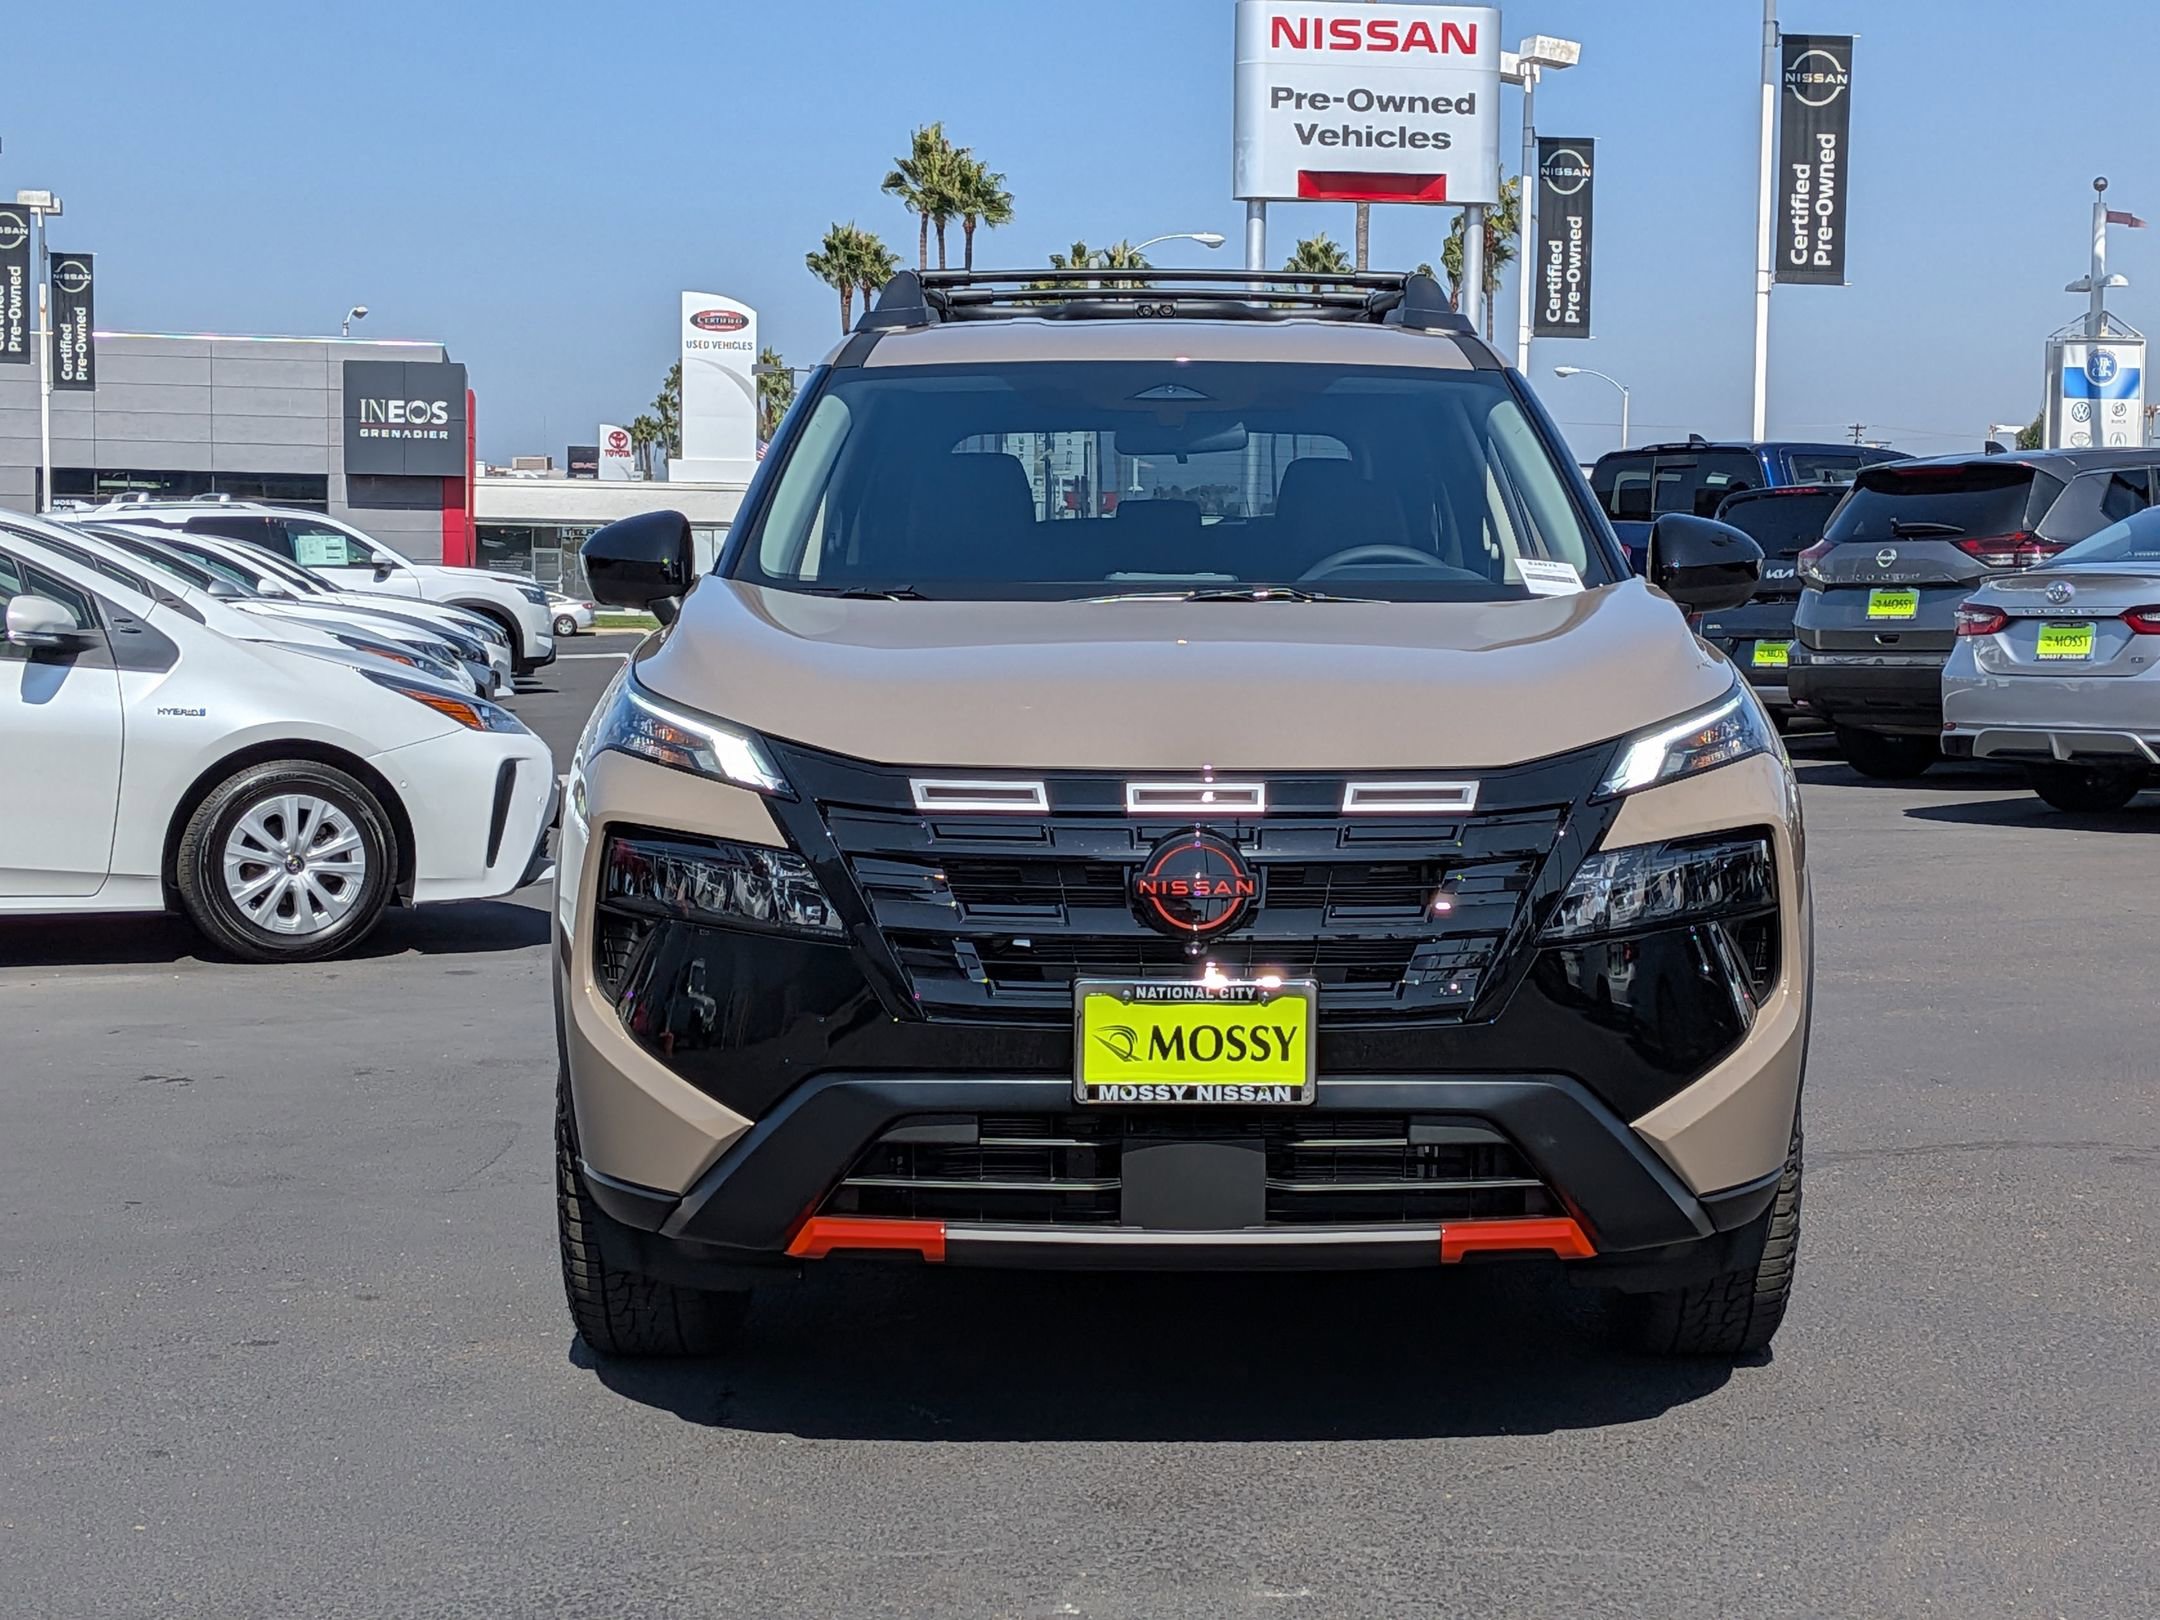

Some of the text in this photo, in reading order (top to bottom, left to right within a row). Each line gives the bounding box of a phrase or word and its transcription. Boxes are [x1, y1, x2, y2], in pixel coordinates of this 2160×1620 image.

[1271, 16, 1477, 54] NISSAN
[1785, 72, 1848, 83] NISSAN
[1271, 86, 1476, 115] Pre-Owned
[1294, 123, 1452, 150] Vehicles
[1540, 166, 1591, 177] NISSAN
[1813, 133, 1837, 266] Pre-Owned
[1790, 163, 1811, 265] Certified
[53, 273, 91, 281] NISSAN
[1546, 240, 1563, 323] Certified
[1565, 215, 1583, 324] Pre-Owned
[7, 265, 22, 352] Pre-Owned
[60, 323, 73, 381] Certified
[74, 306, 88, 381] Pre-Owned
[686, 340, 753, 351] USED VEHICLES
[359, 398, 449, 425] INEOS
[359, 428, 449, 440] GRENADIER
[1139, 879, 1254, 896] NISSAN
[1135, 985, 1256, 1000] NATIONAL CITY
[1147, 1024, 1298, 1062] MOSSY
[1098, 1084, 1292, 1102] MOSSY NISSAN
